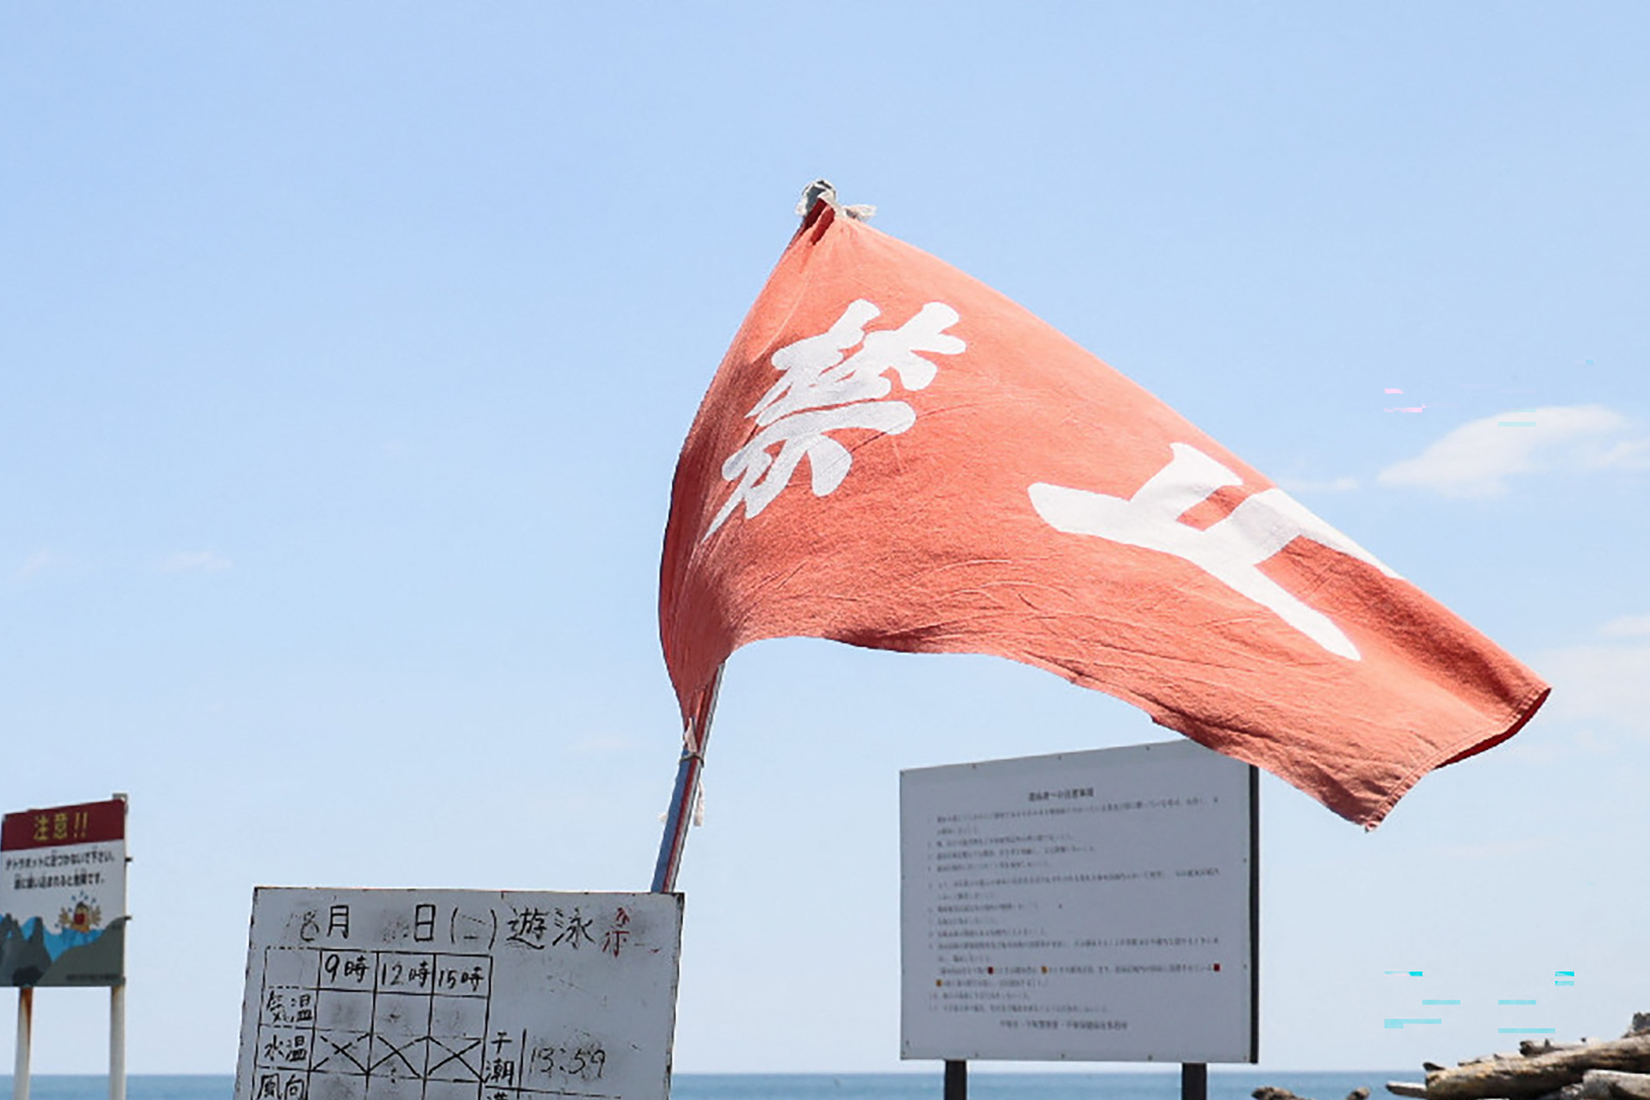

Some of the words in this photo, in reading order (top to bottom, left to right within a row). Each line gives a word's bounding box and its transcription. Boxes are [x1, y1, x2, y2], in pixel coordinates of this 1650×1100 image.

[325, 954, 369, 983] 9時
[382, 960, 430, 987] 12時
[439, 966, 484, 991] 15時
[264, 1034, 307, 1062] 水温
[484, 1032, 515, 1086] 干潮
[257, 1073, 305, 1100] 風向
